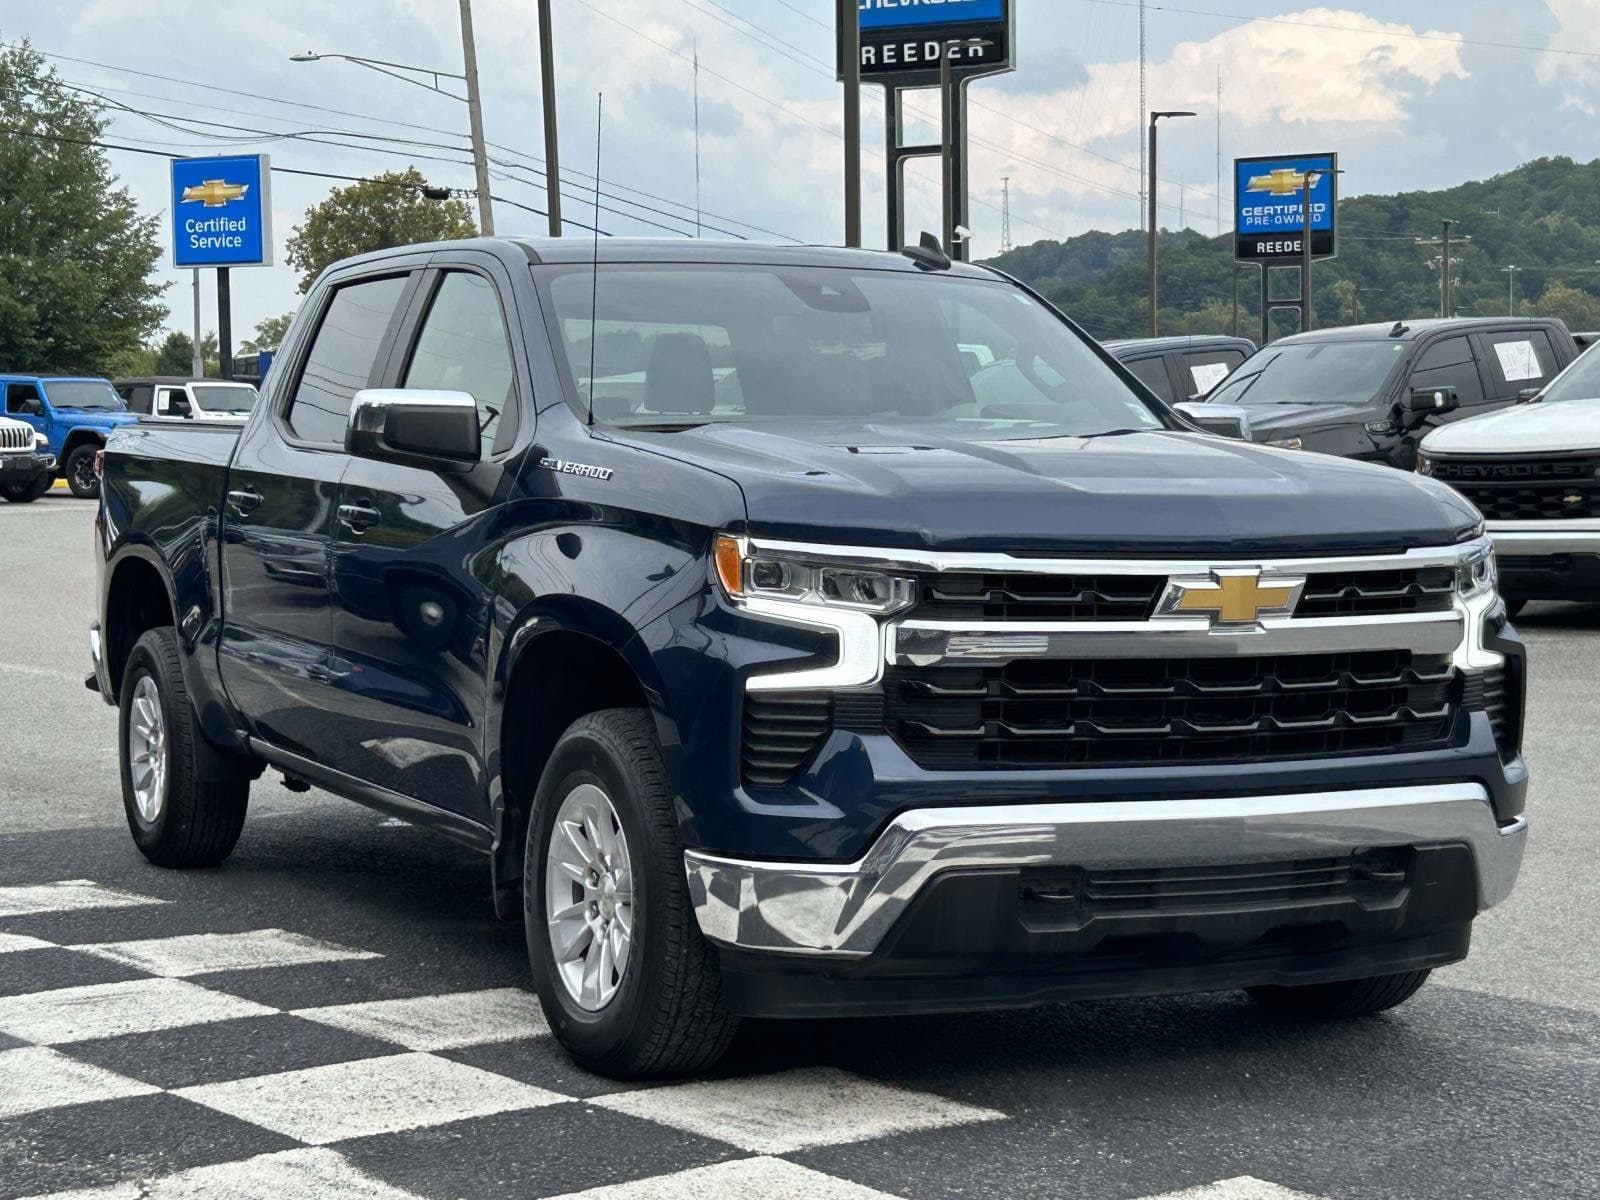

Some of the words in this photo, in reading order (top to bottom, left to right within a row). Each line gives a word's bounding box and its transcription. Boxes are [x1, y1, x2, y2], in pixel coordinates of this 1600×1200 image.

[861, 38, 983, 65] REEDER
[1241, 203, 1326, 216] CERTIFID
[185, 216, 246, 233] Certified
[1246, 213, 1322, 226] PRE-OWND
[190, 233, 242, 249] Service
[1256, 240, 1304, 253] REEDE
